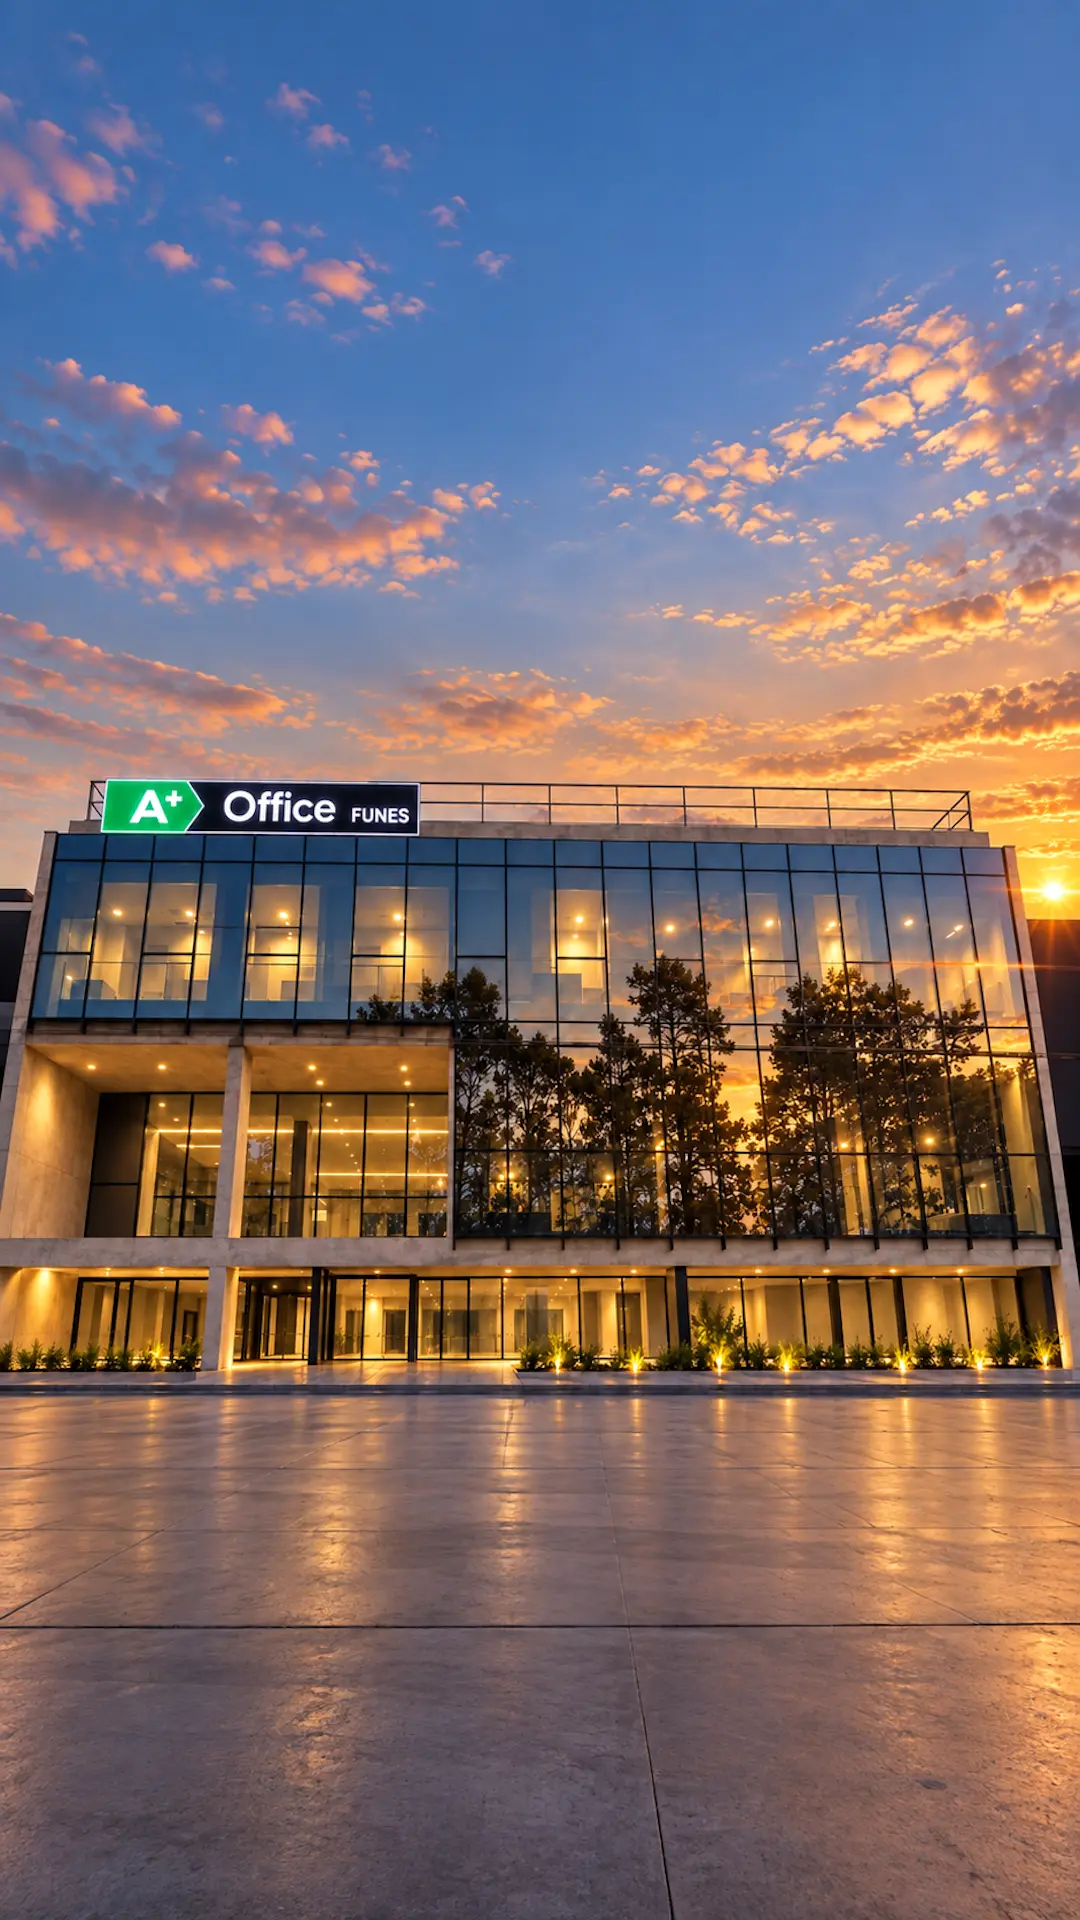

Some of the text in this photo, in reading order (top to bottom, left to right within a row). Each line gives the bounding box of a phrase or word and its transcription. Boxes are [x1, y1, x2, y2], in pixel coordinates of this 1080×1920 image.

[129, 789, 410, 824] A+ Office FUNES
